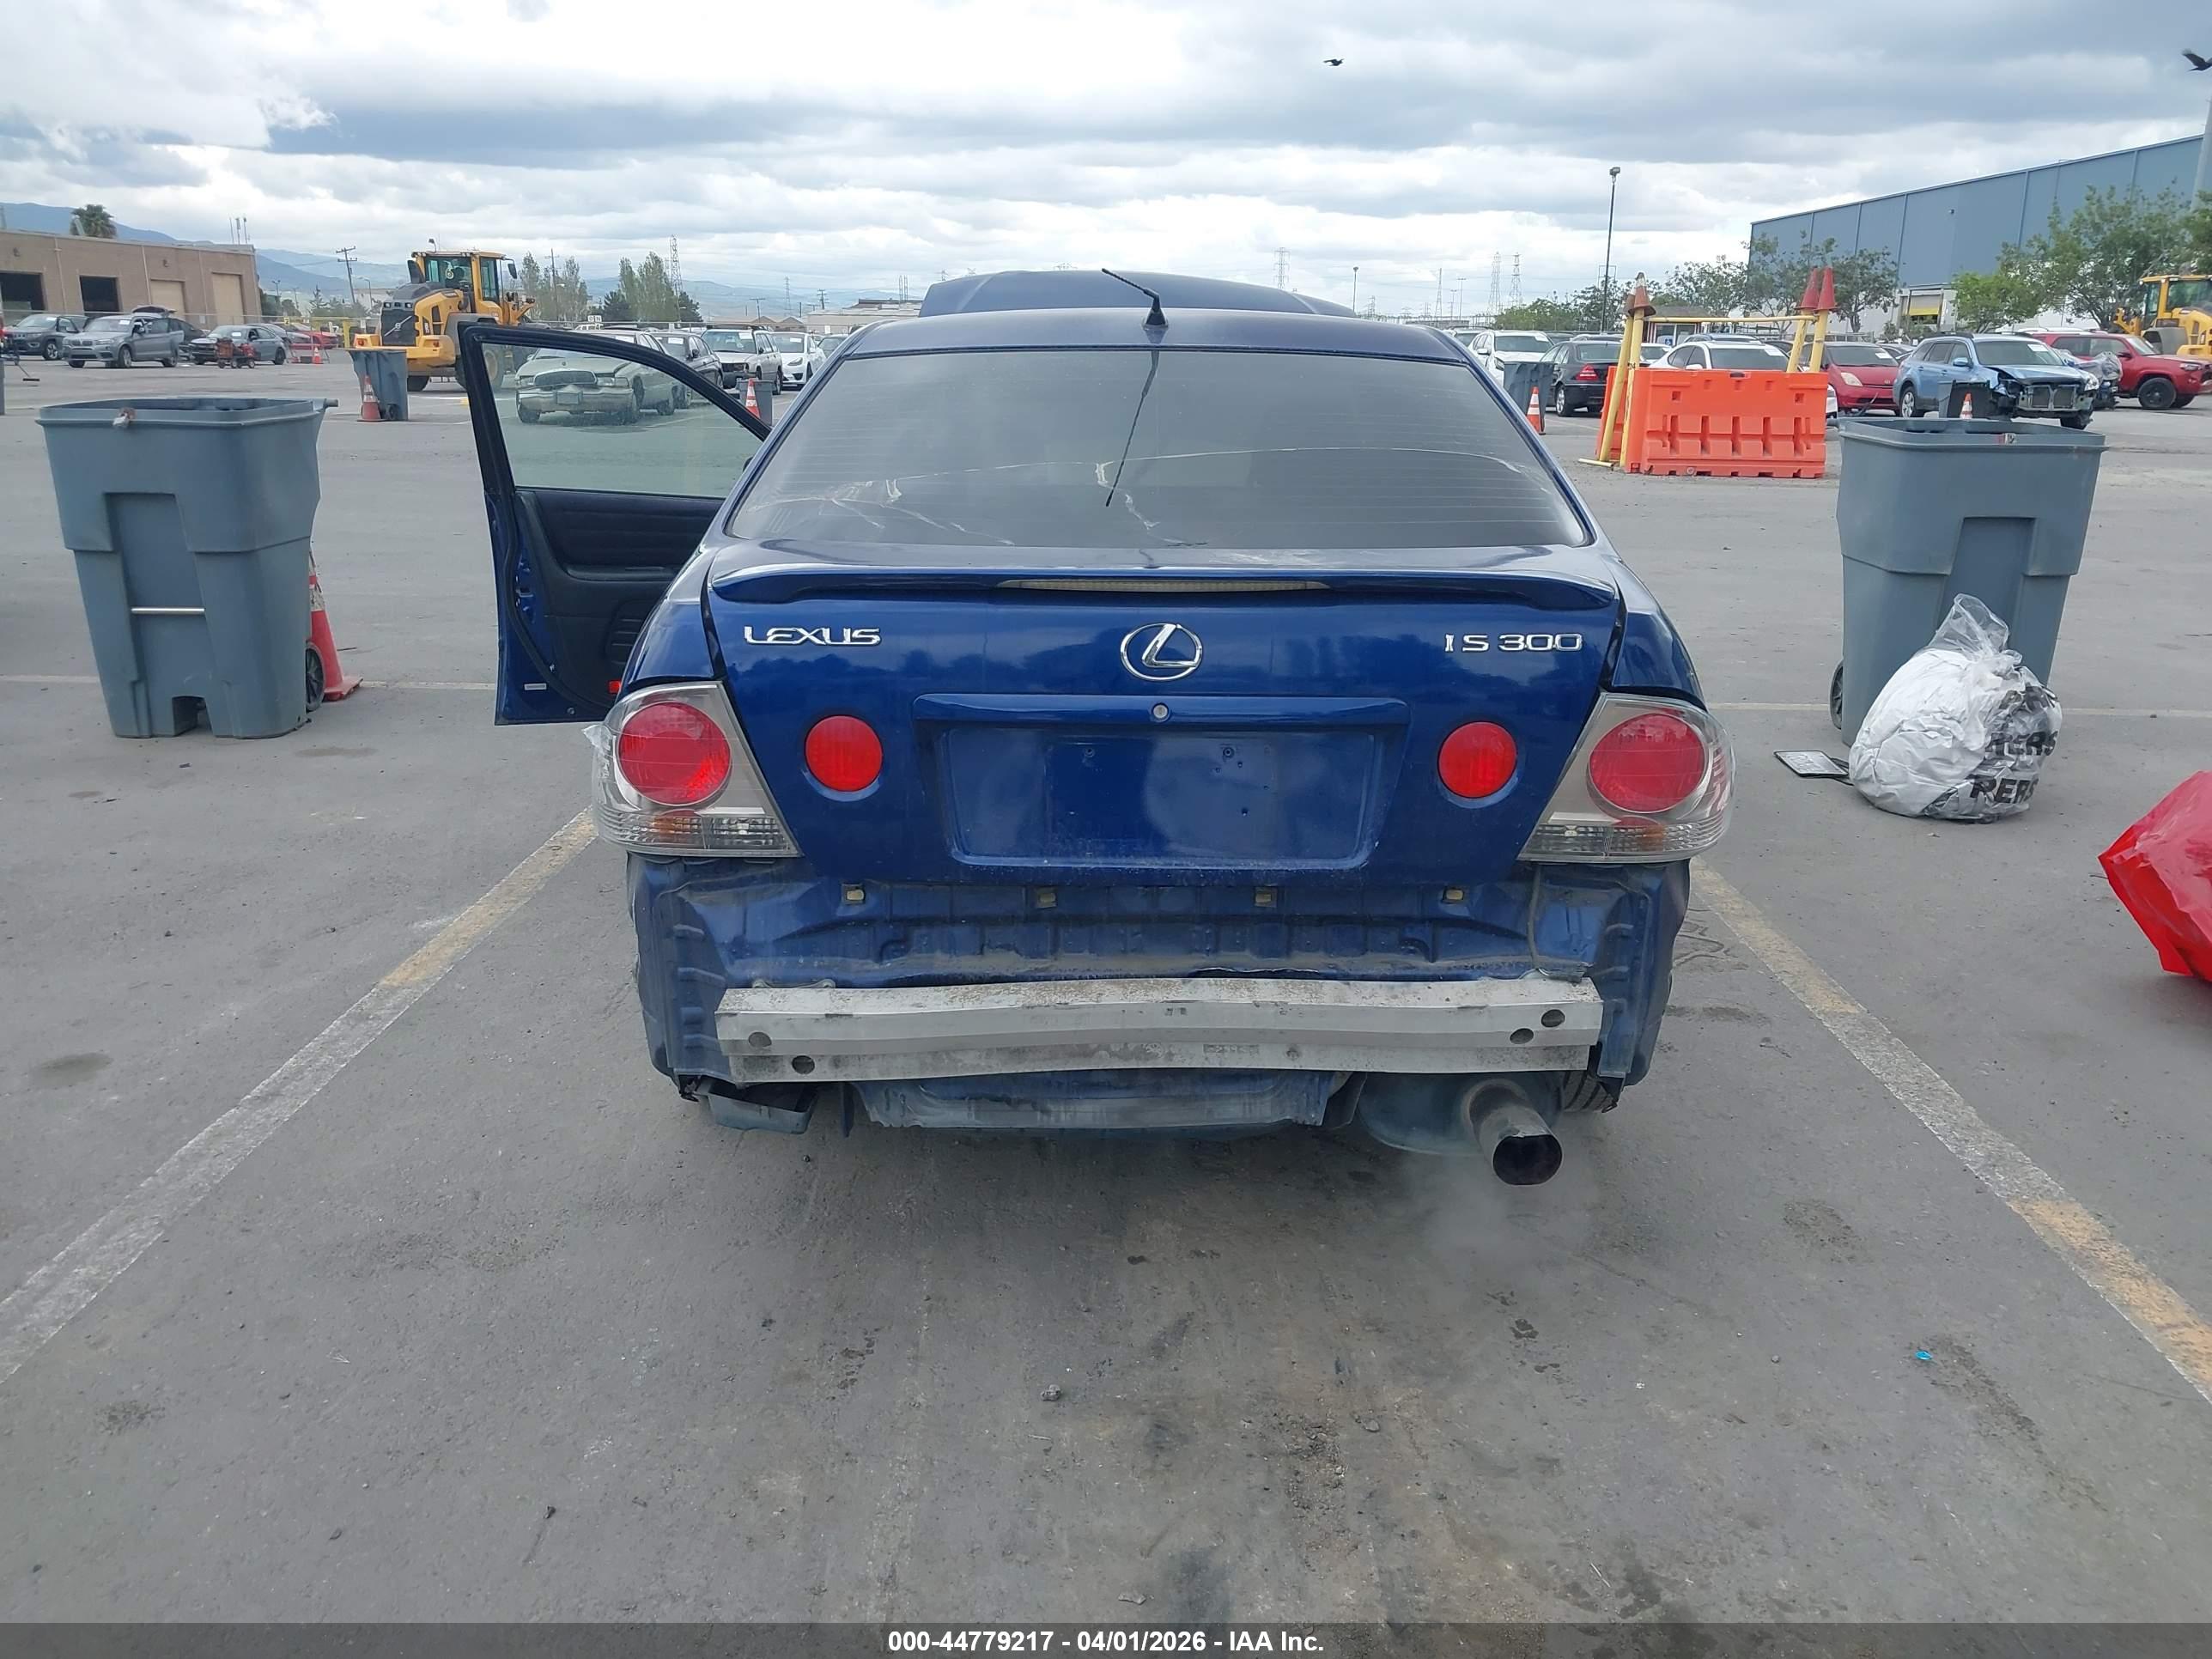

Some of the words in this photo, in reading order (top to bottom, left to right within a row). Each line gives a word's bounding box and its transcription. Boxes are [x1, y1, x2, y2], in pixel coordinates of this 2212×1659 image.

[744, 626, 882, 646] LEXUS
[1444, 634, 1490, 652] IS
[1498, 633, 1583, 652] 300
